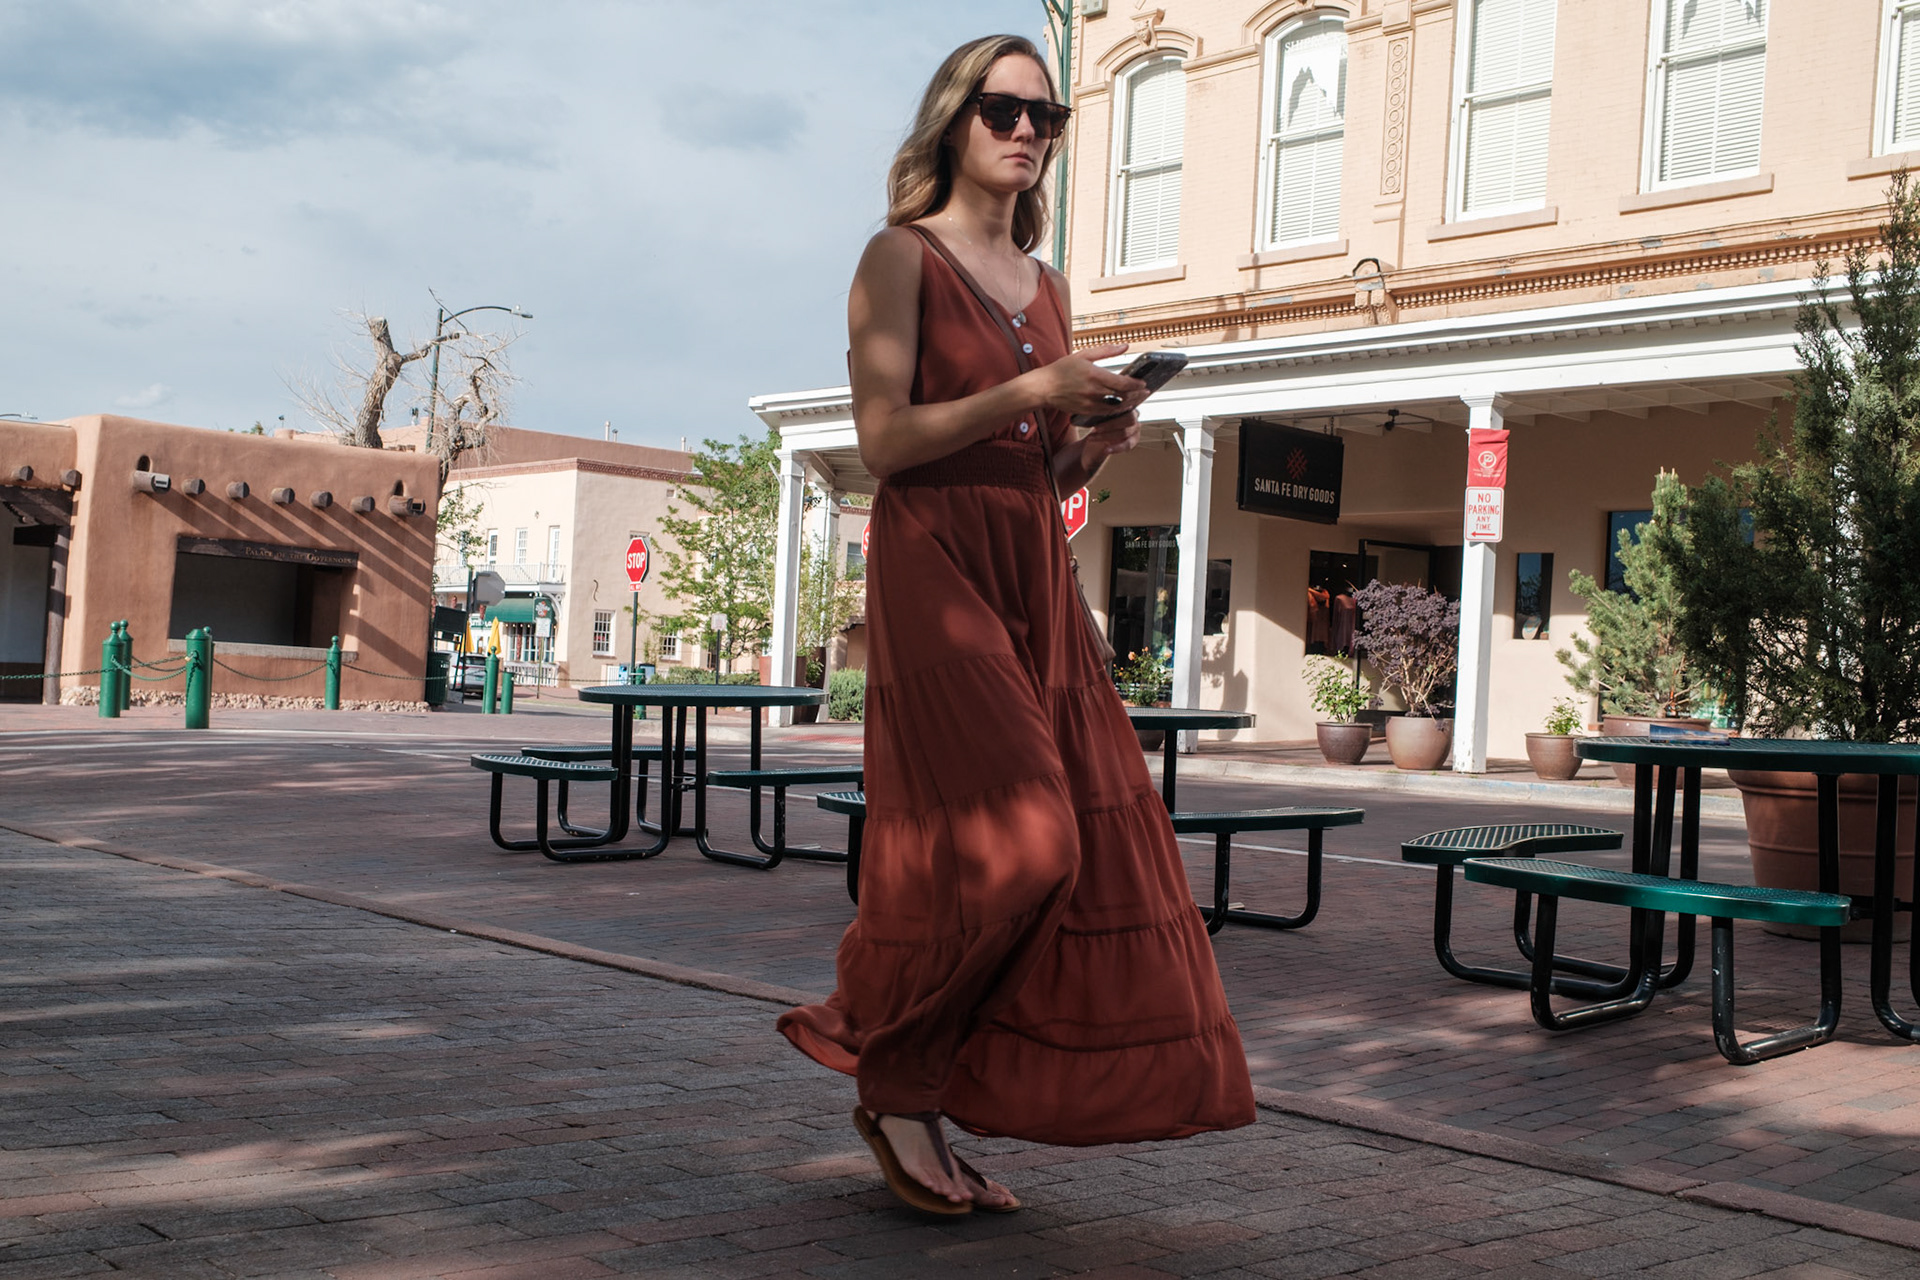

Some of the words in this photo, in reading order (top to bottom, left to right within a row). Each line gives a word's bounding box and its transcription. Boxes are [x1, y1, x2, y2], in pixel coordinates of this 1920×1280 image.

[1254, 477, 1280, 495] SANTA
[1281, 482, 1291, 497] FE
[1292, 484, 1309, 500] DRY
[1309, 487, 1335, 504] GOODS
[1477, 492, 1492, 503] NO
[1468, 504, 1500, 515] PARKING
[1476, 515, 1491, 523] ANY
[1475, 523, 1491, 531] TIME
[1124, 540, 1141, 549] SANTA
[1141, 540, 1148, 549] FE
[1148, 540, 1158, 549] DRY
[1159, 540, 1176, 549] GOODS
[627, 551, 646, 569] STOP
